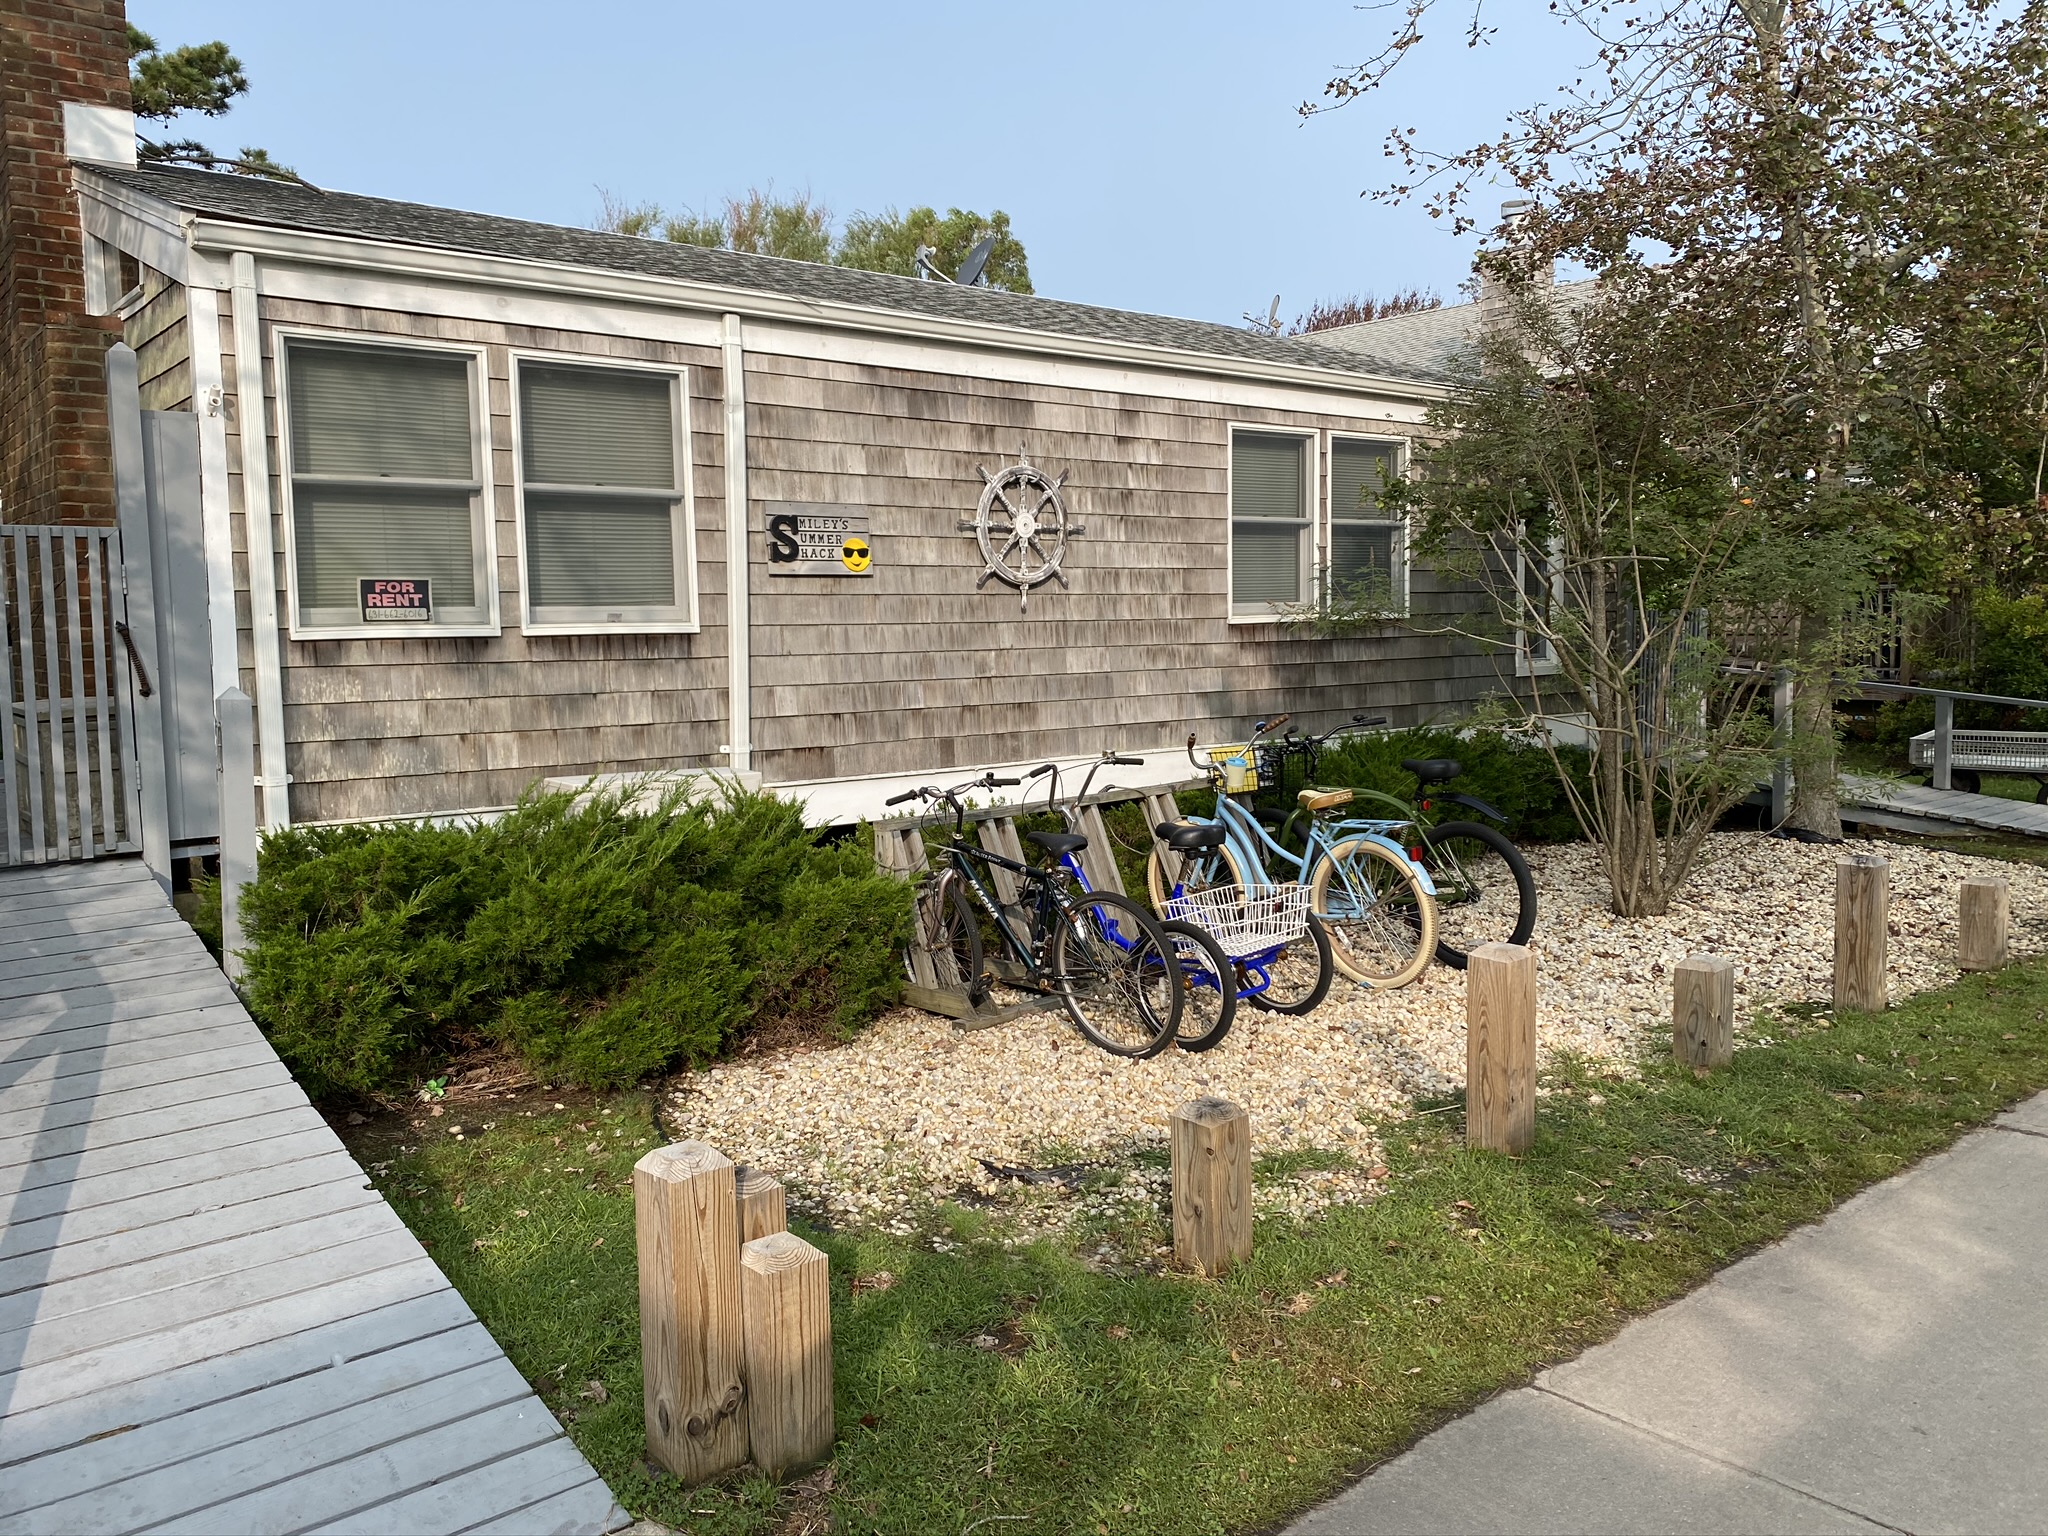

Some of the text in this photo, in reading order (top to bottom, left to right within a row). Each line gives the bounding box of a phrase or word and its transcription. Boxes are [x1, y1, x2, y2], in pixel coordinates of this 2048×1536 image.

[375, 582, 415, 593] FOR
[367, 593, 423, 607] RENT
[969, 879, 999, 920] MAGNA
